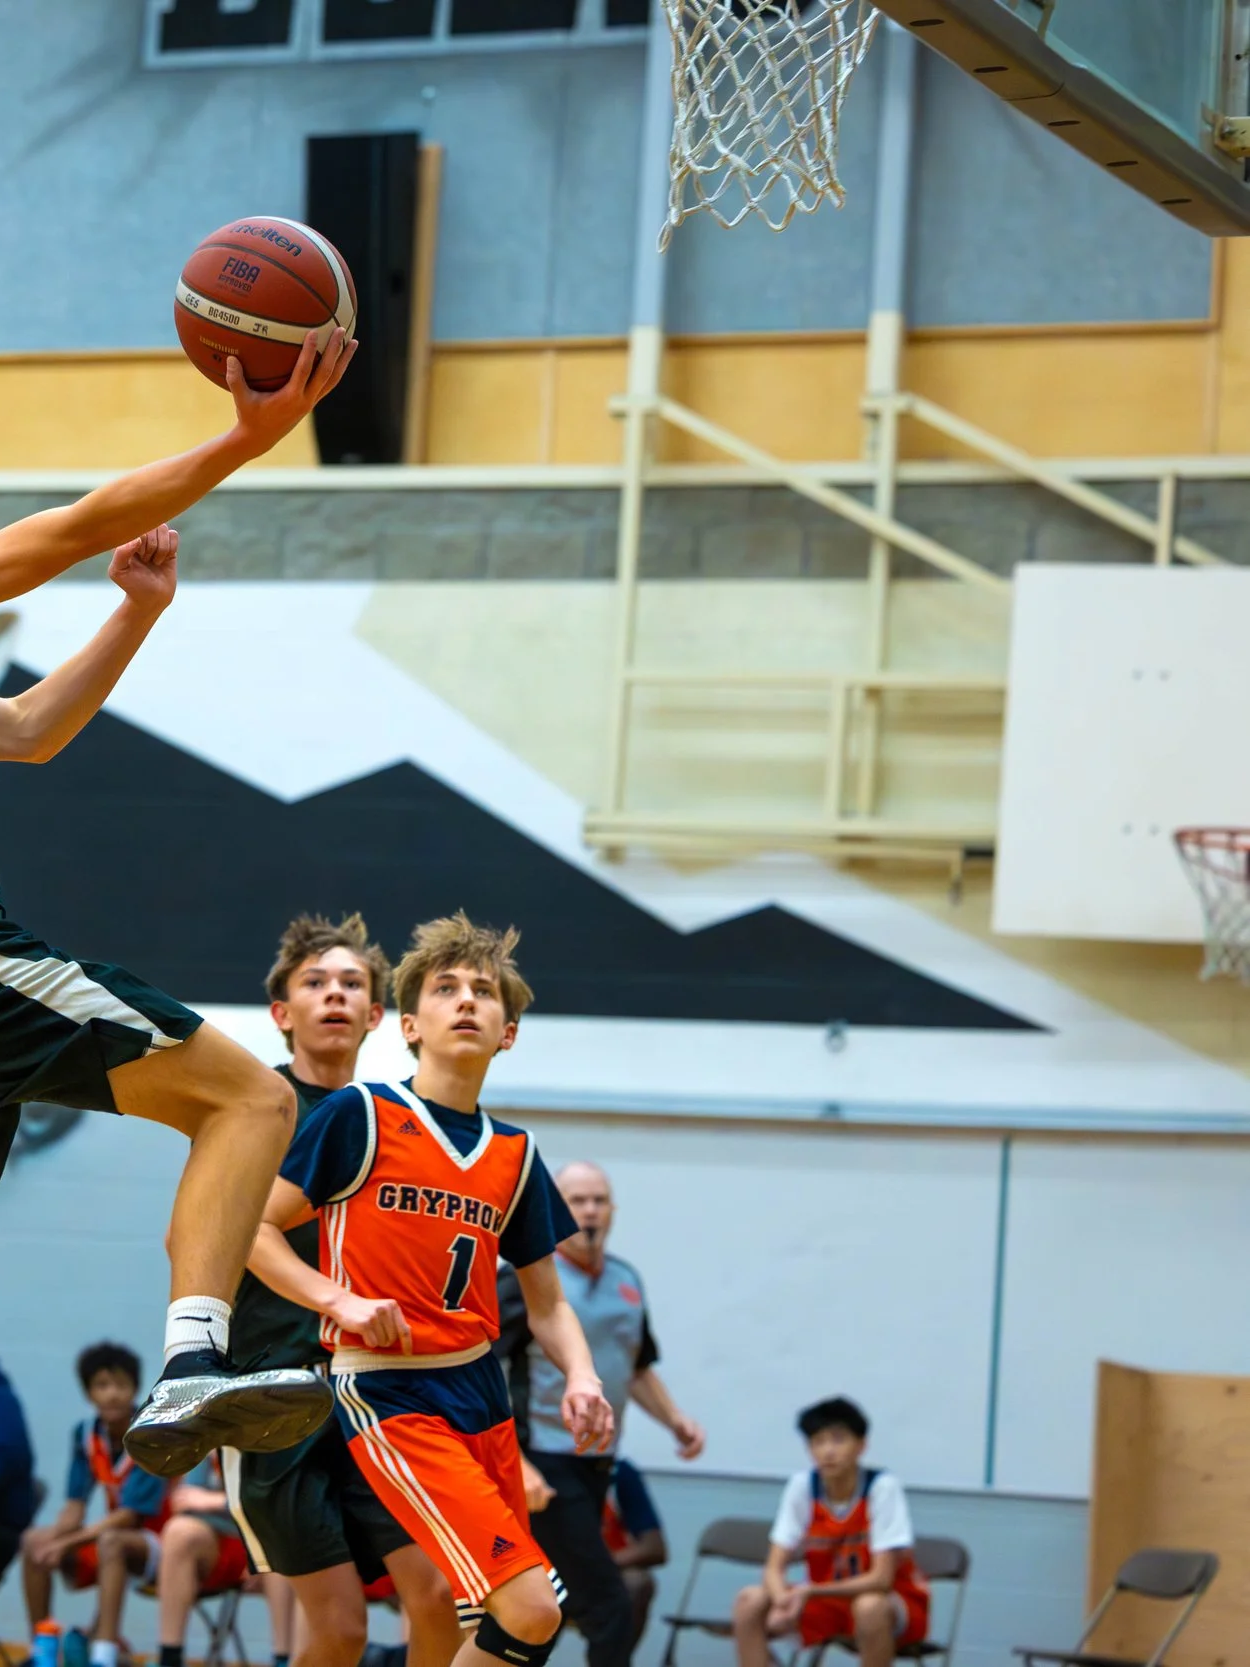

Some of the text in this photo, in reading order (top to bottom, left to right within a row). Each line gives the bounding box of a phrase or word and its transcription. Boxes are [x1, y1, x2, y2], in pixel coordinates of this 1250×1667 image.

[230, 225, 302, 257] molten
[219, 274, 252, 292] APPROVED
[222, 256, 261, 283] FIBA
[208, 306, 240, 325] BG4500
[442, 1233, 478, 1313] 1
